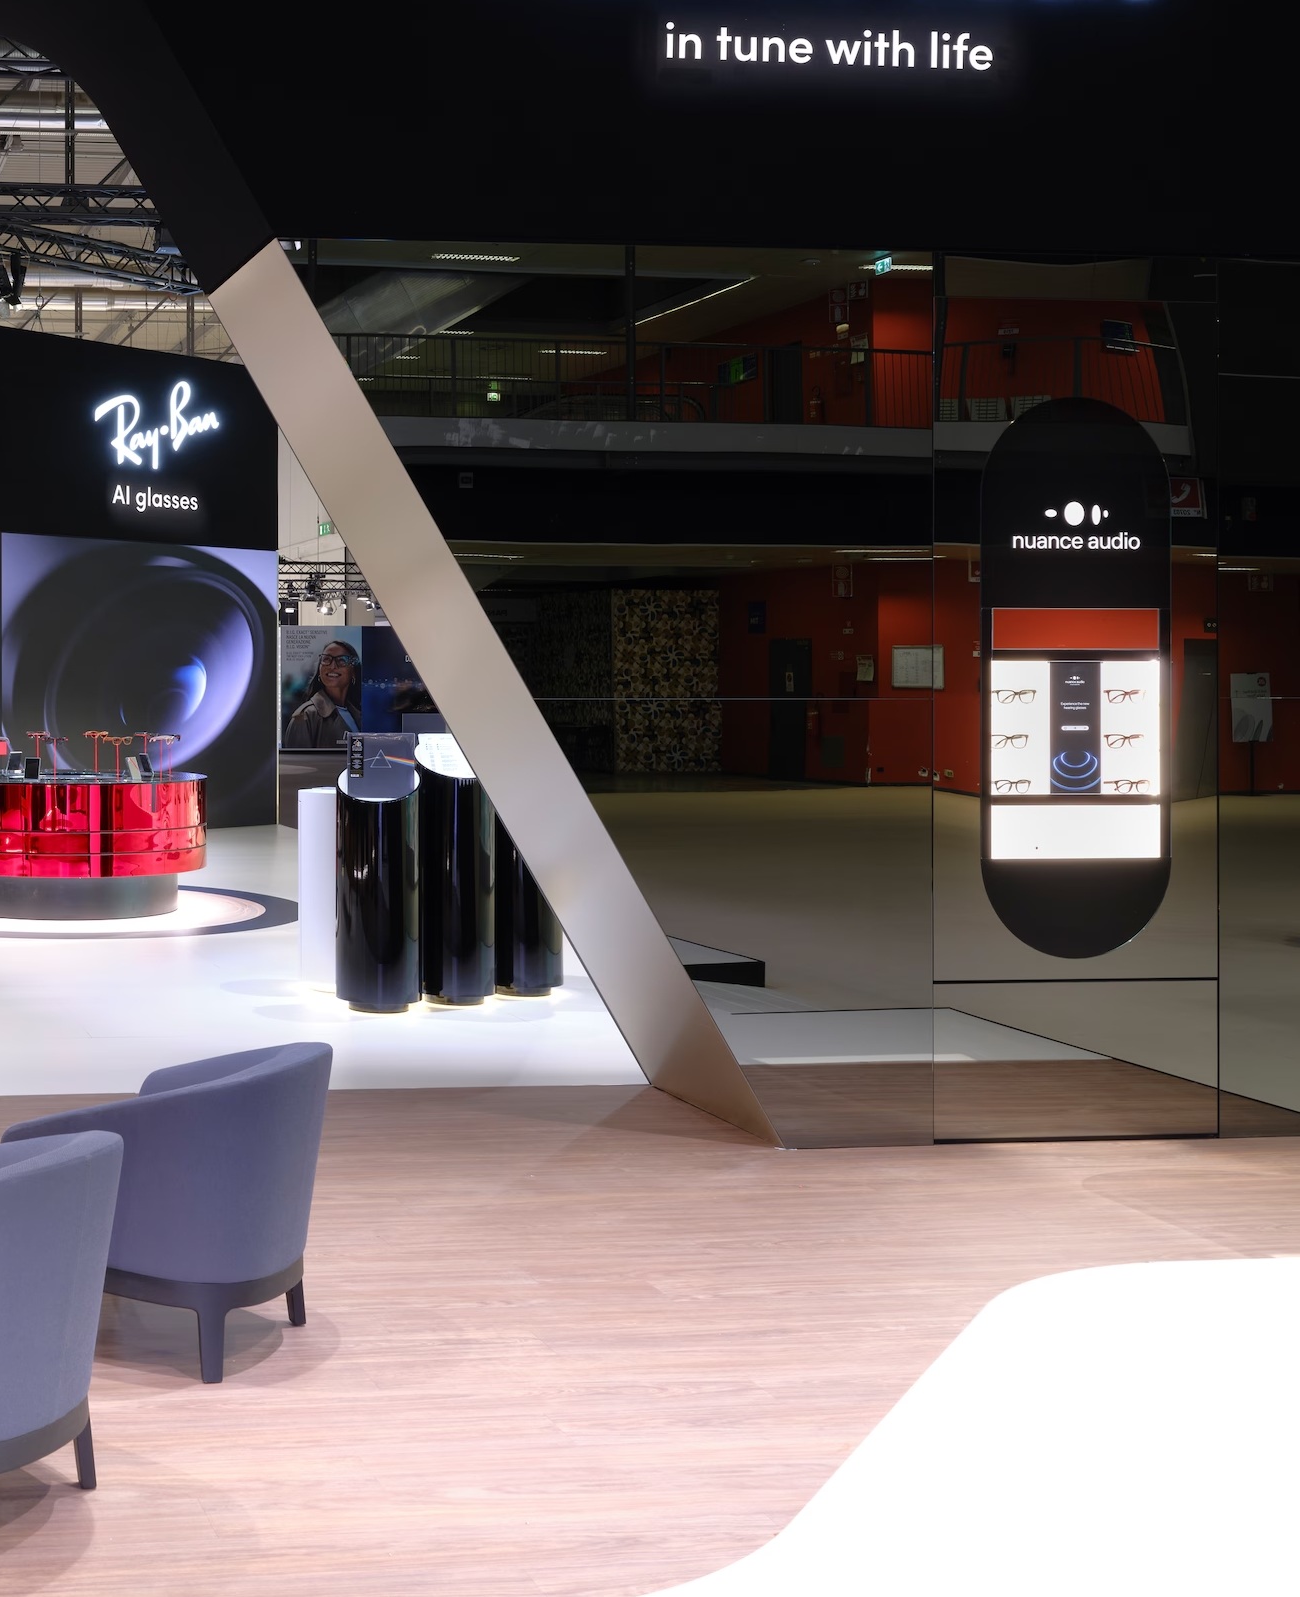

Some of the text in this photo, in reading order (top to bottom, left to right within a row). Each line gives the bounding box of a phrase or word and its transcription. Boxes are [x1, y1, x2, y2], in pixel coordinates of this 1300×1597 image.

[665, 21, 994, 71] in tune with life
[111, 484, 199, 513] AI glasses
[1012, 531, 1141, 550] nuance audio
